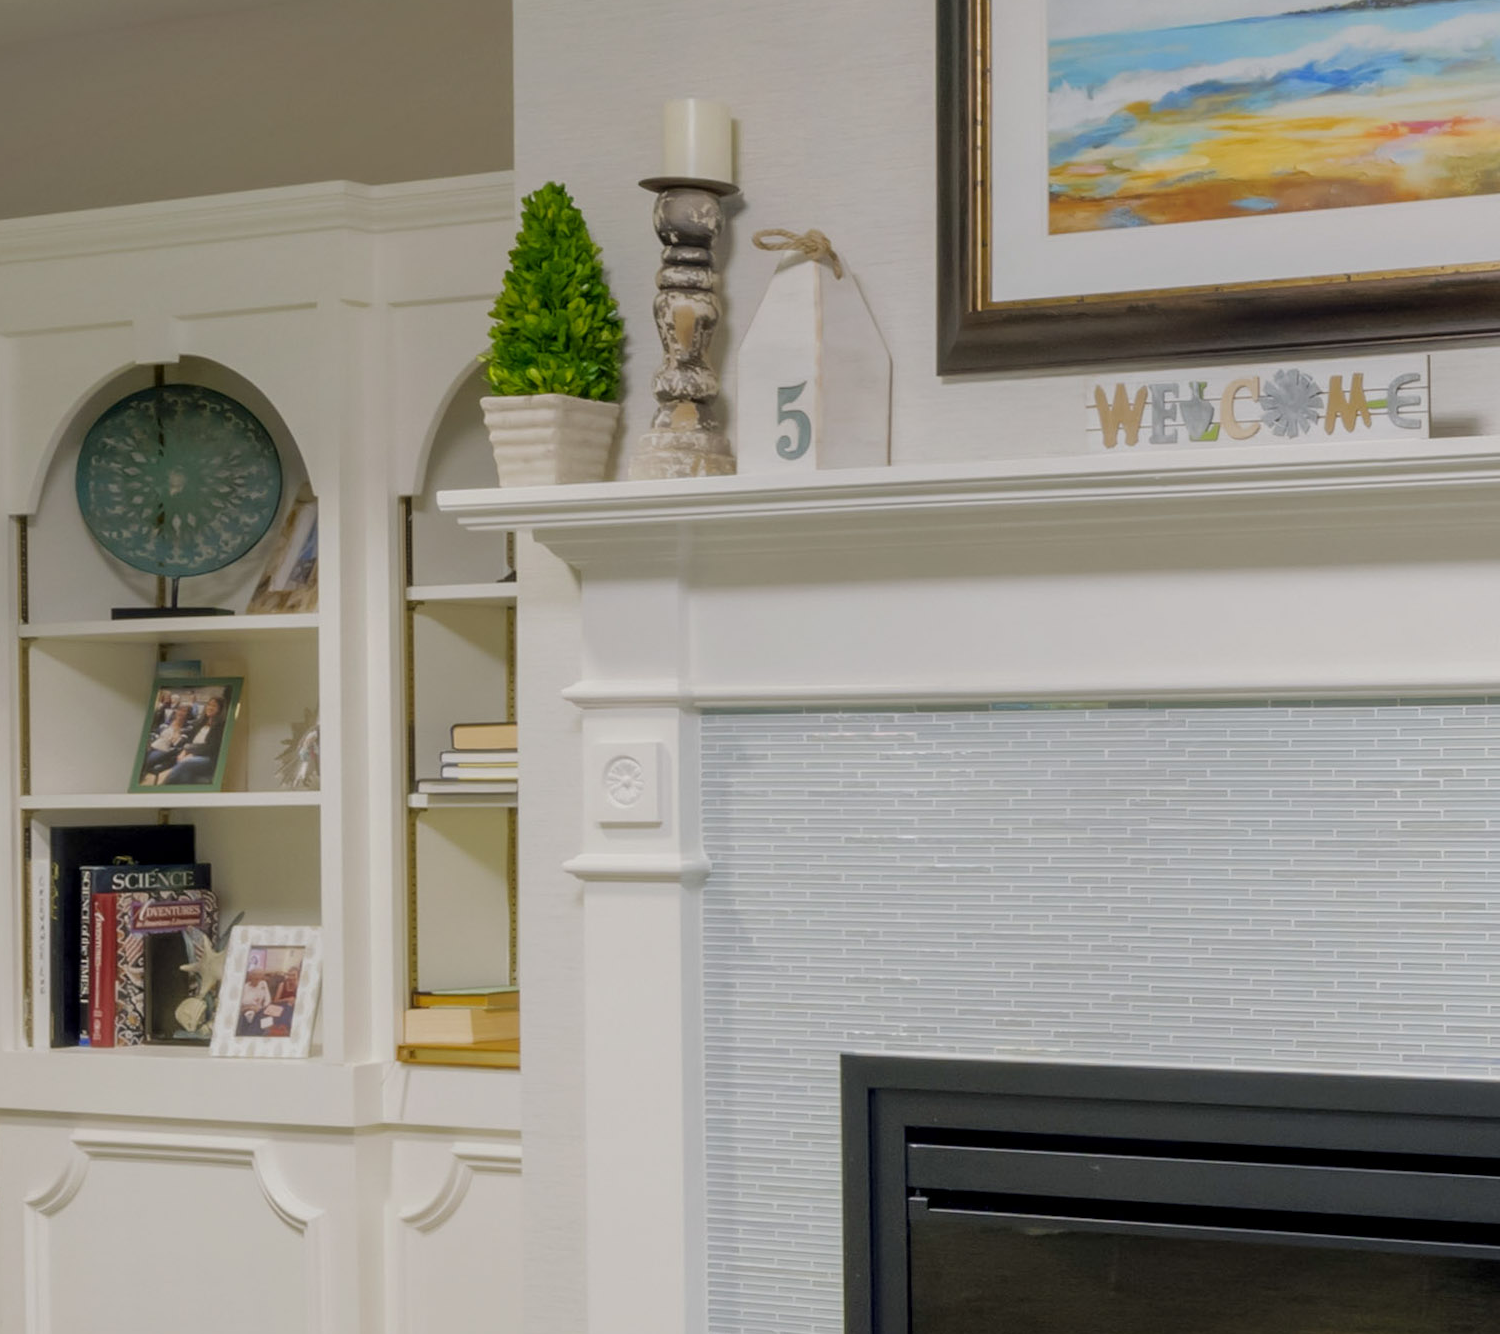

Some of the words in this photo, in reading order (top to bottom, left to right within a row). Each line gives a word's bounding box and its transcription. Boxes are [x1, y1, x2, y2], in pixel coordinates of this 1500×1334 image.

[776, 381, 811, 460] 5
[80, 871, 90, 925] SCIENCE
[112, 870, 195, 890] SCIENCE
[136, 899, 200, 921] ADVENTURES
